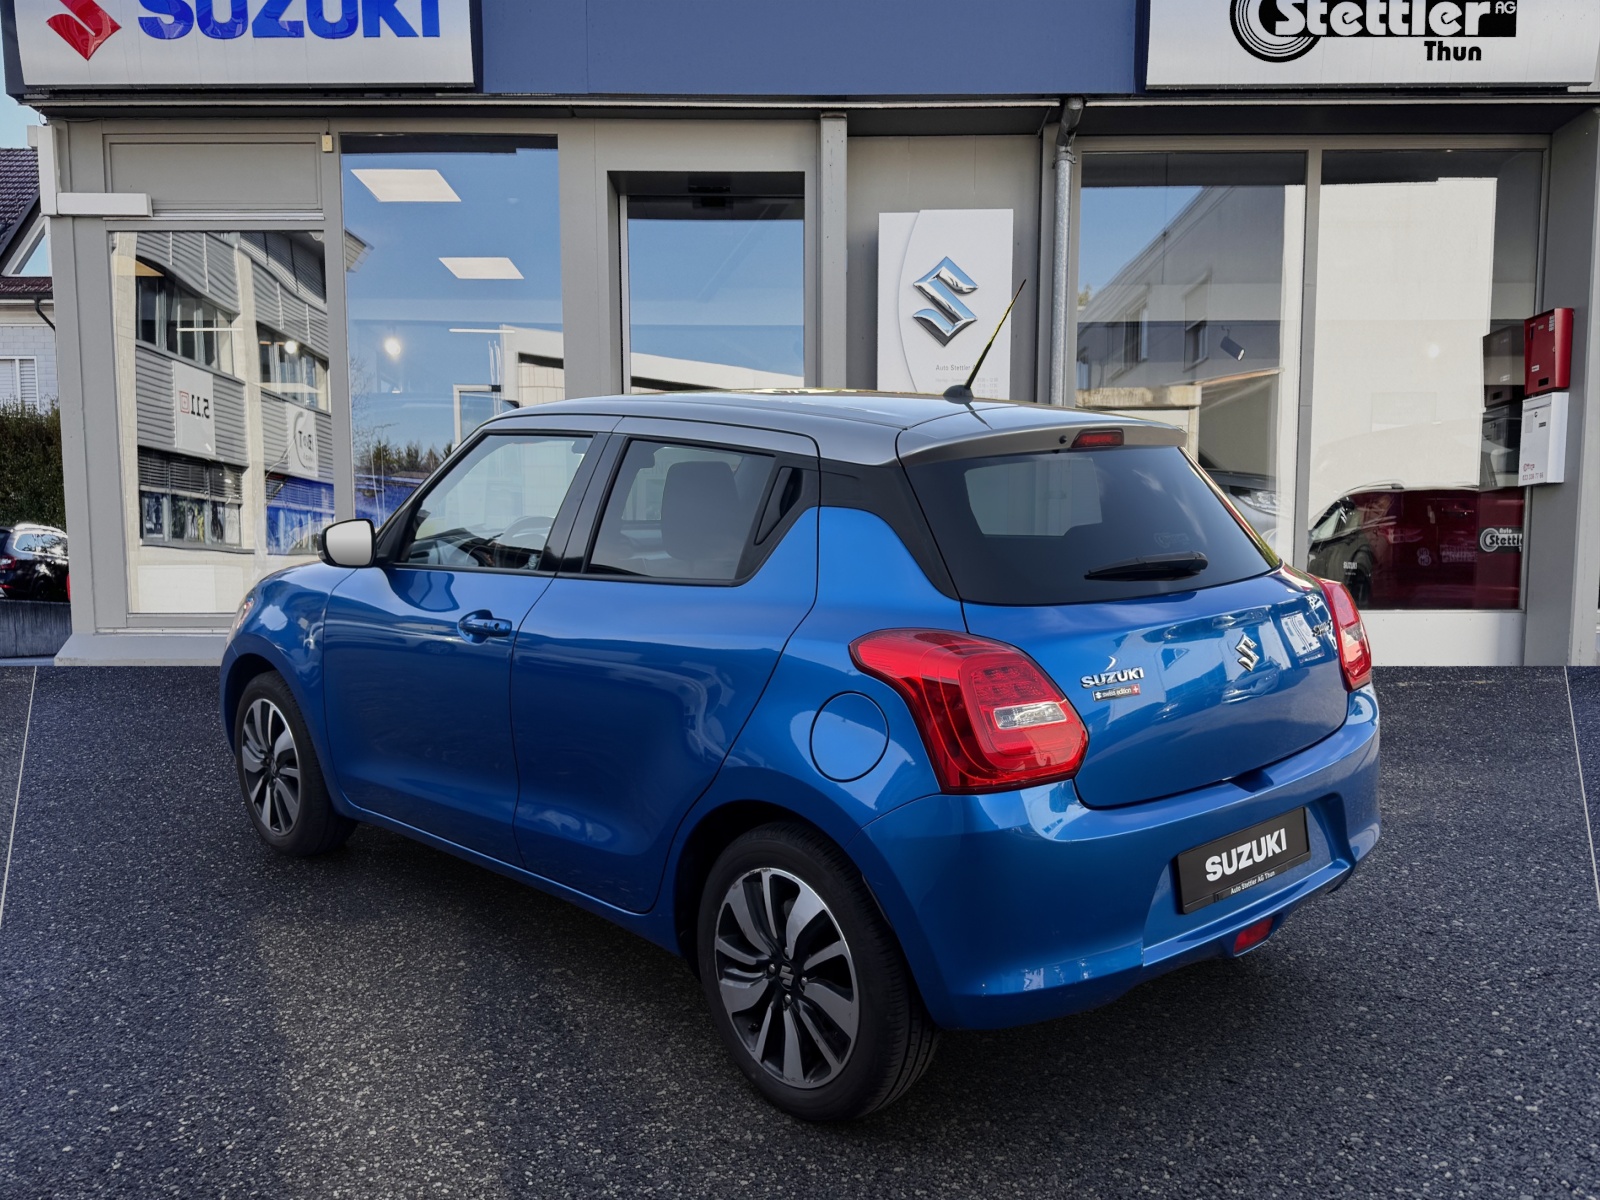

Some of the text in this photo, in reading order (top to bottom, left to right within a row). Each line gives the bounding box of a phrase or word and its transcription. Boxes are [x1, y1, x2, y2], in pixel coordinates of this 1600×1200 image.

[138, 0, 439, 39] SUZUKI
[1275, 0, 1517, 36] Stettler AG
[1424, 41, 1482, 61] Thun
[1489, 534, 1523, 546] Stettl
[1081, 667, 1144, 688] SUZUKI
[1205, 828, 1287, 882] SUZUKI
[1230, 870, 1276, 895] Auto Stettler AG Thun
